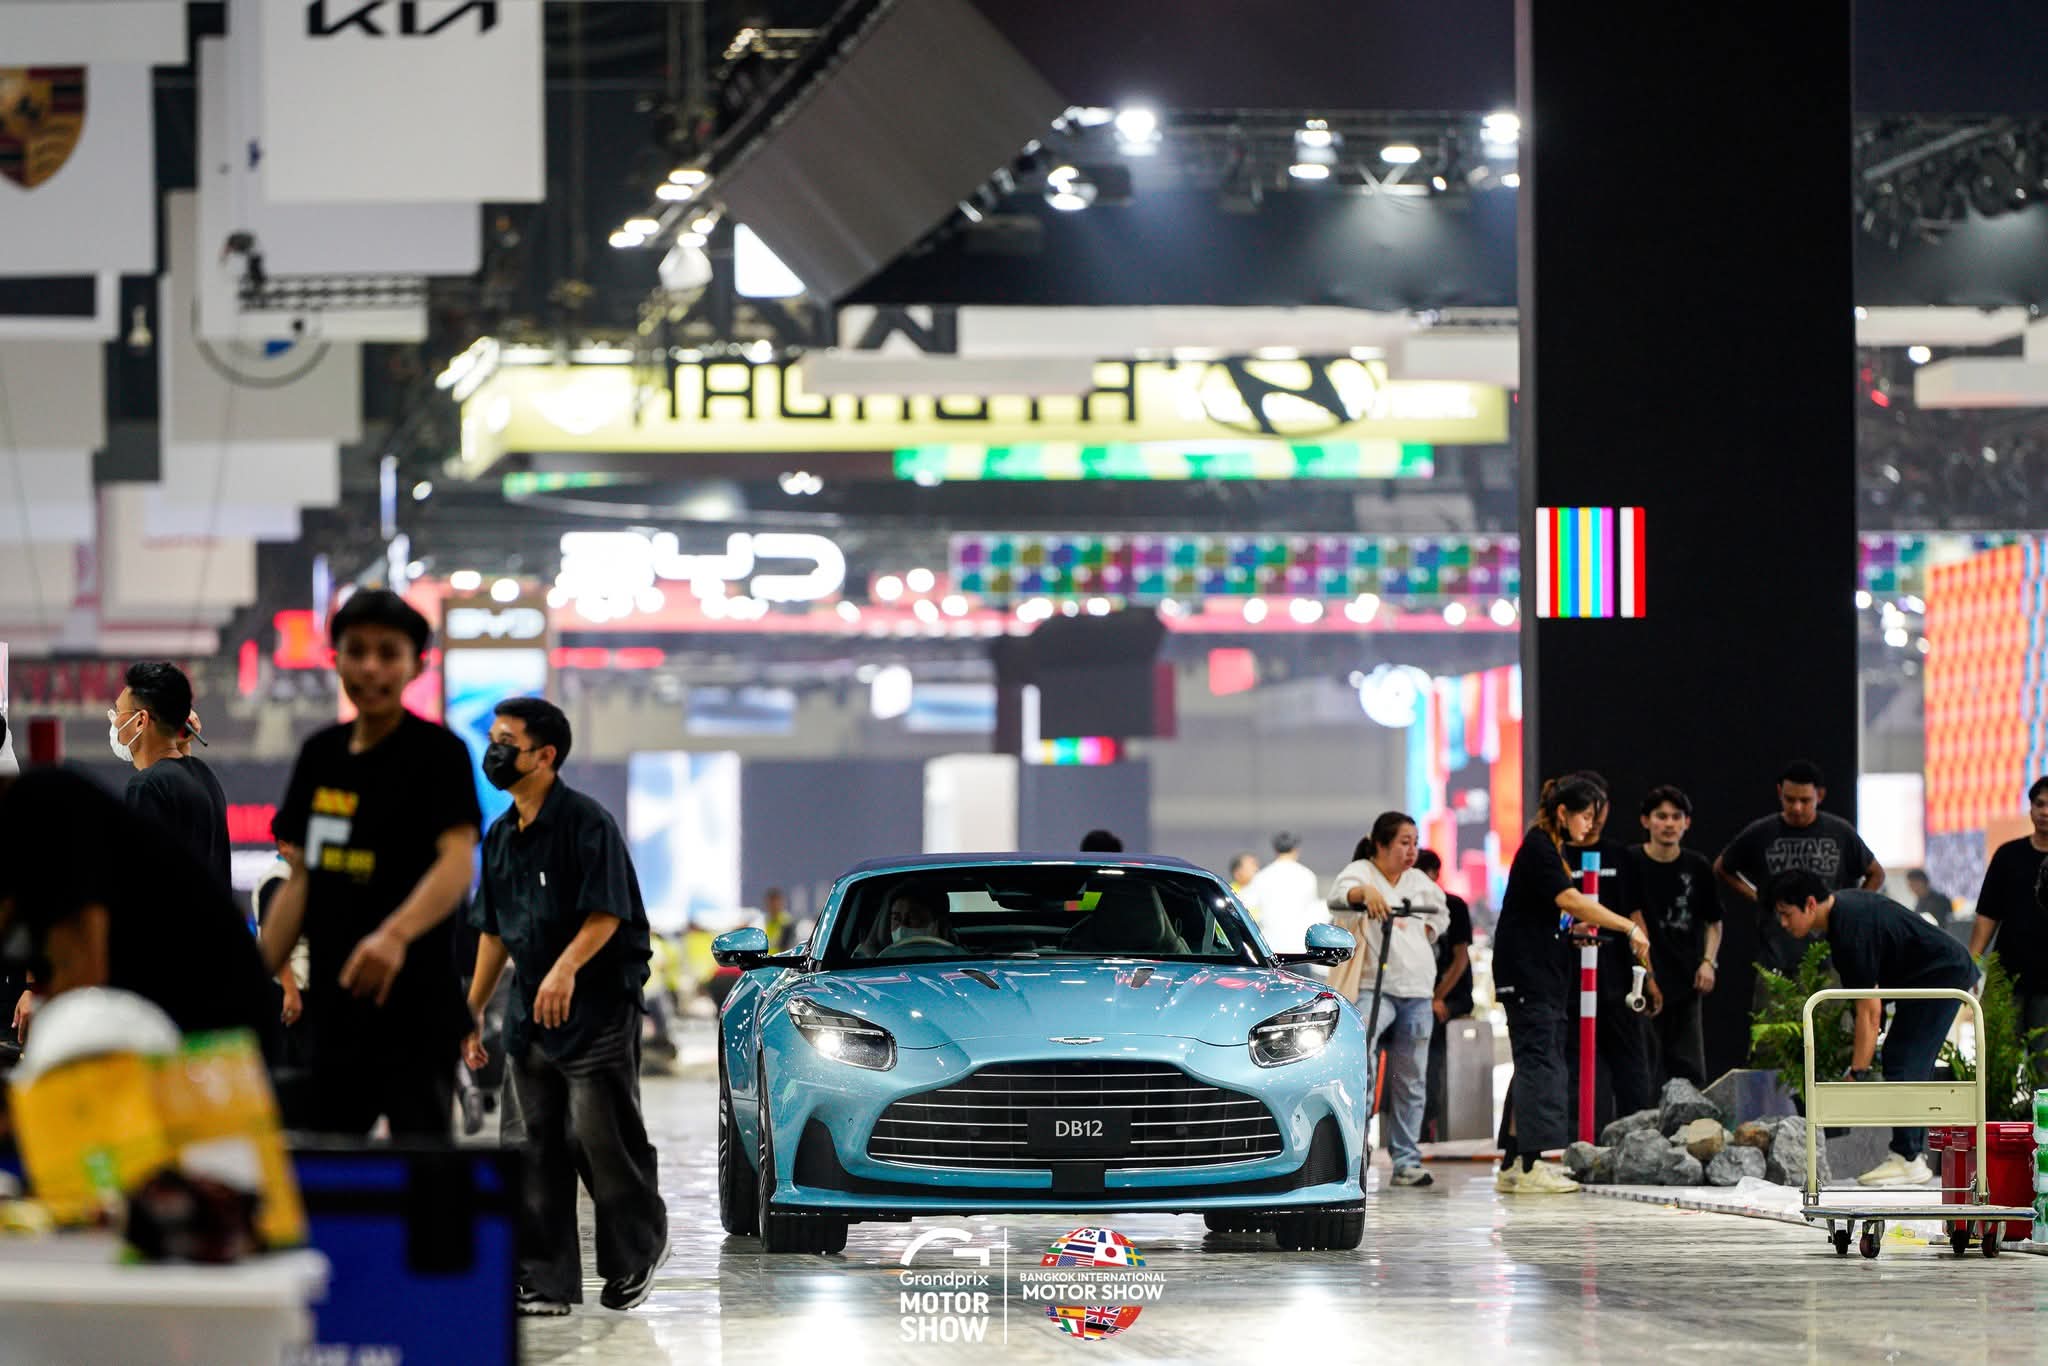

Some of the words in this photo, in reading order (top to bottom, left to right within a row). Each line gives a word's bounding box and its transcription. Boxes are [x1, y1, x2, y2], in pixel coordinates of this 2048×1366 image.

[1766, 838, 1840, 857] STAR
[1766, 856, 1840, 877] WARS
[1055, 1120, 1104, 1137] DB12
